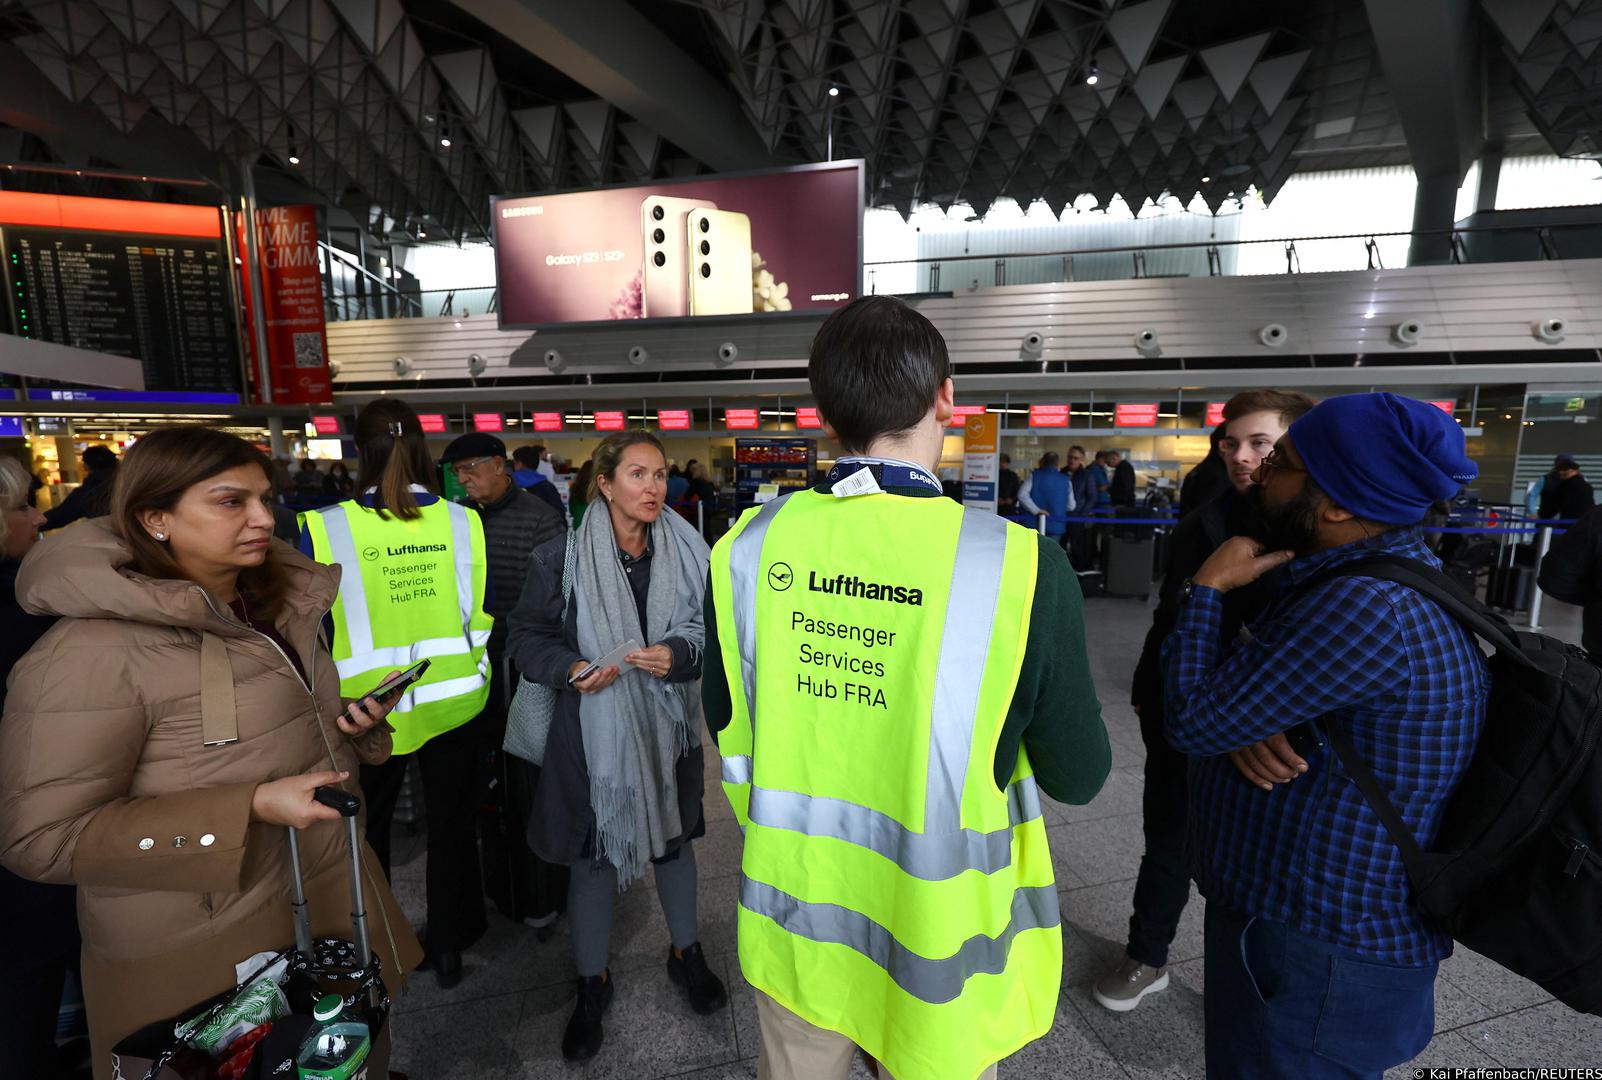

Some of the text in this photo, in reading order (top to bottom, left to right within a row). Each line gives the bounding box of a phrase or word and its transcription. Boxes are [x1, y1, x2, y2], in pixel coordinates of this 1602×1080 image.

[502, 205, 544, 218] SAMSUNG
[545, 253, 581, 267] Galaxy
[582, 252, 599, 263] S23
[387, 544, 447, 556] Lufthansa
[382, 562, 437, 576] Passenger
[389, 577, 434, 590] Services
[808, 571, 923, 606] Lufthansa
[391, 588, 437, 603] Hub FRA
[791, 611, 896, 647] Passenger
[799, 643, 885, 678] Services
[797, 673, 888, 710] Hub FRA
